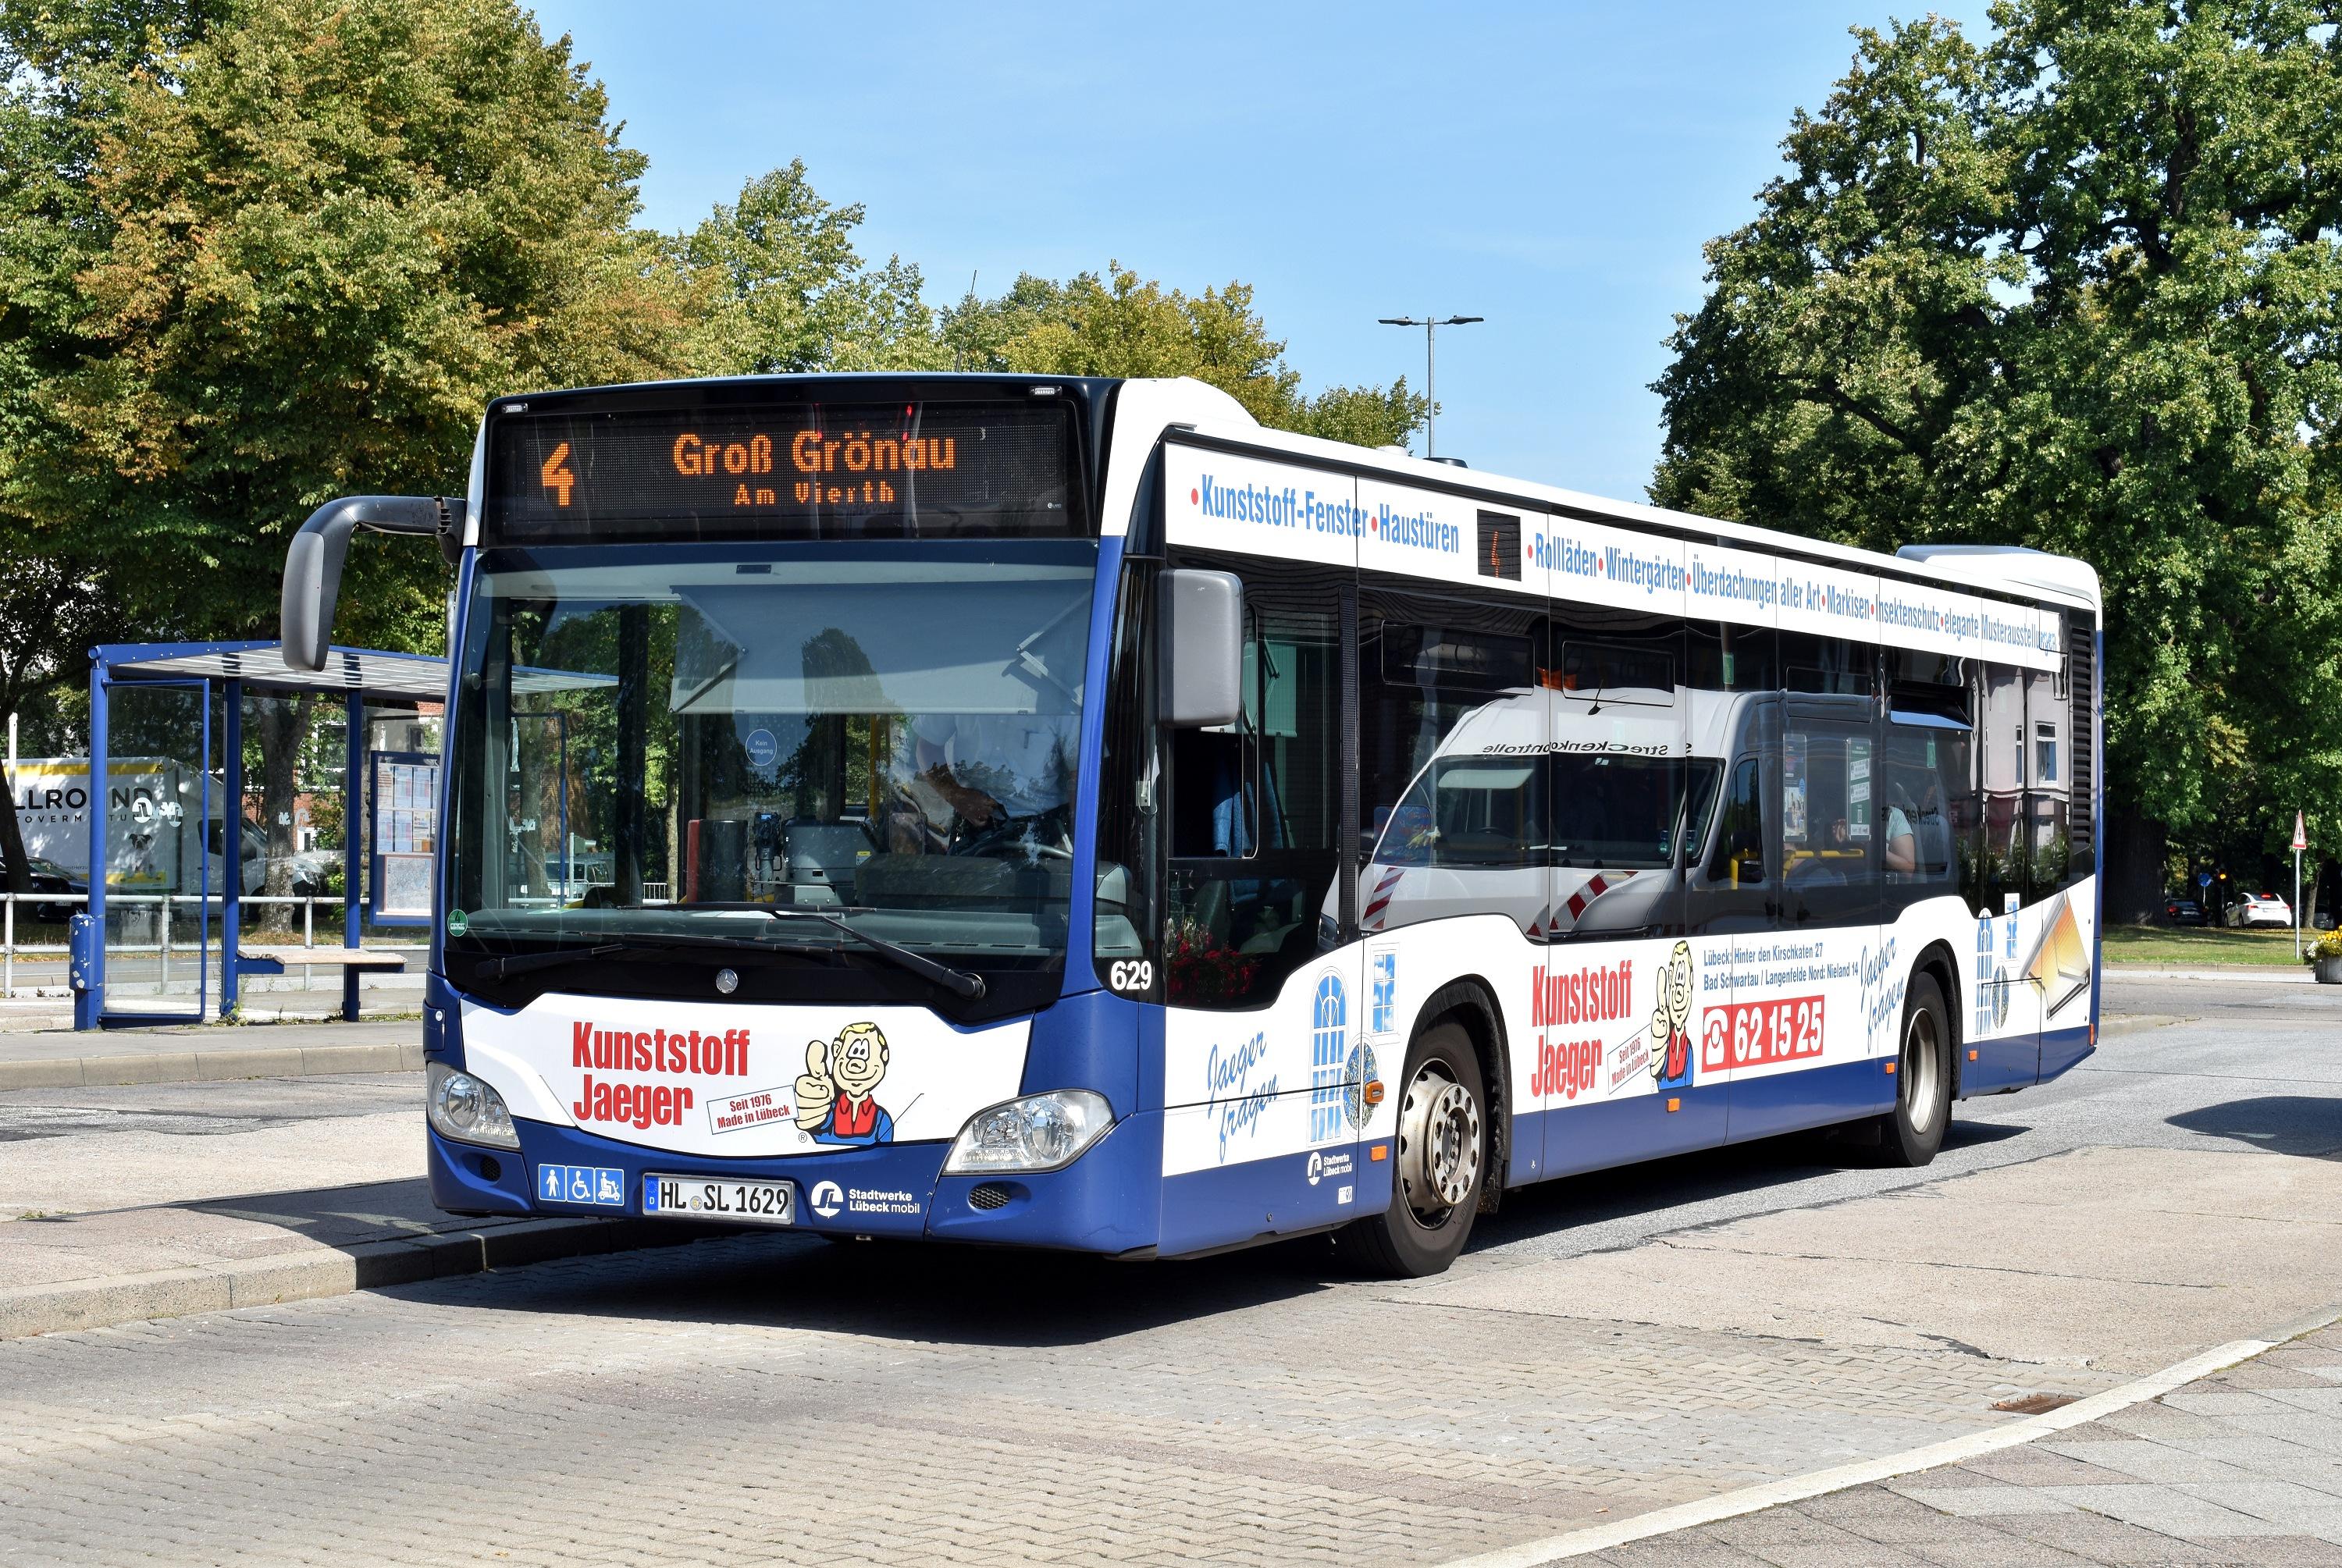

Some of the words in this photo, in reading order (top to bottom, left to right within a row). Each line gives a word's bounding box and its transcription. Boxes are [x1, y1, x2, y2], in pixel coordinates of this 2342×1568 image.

[673, 434, 772, 475] Groß
[792, 430, 956, 471] Grönau
[542, 443, 575, 507] 4
[735, 483, 776, 505] Am
[795, 481, 895, 504] Vierth
[1201, 474, 1369, 539] Kunststoff-Fenster
[1379, 503, 1460, 553] Haustüren
[1536, 532, 1596, 578] Rollläden
[1605, 546, 1685, 595] Wintergärten
[1692, 553, 1777, 610] Überdachungen
[1781, 576, 1803, 609] aller
[1806, 581, 1821, 612] Art
[1827, 585, 1870, 620] Markisen
[1875, 593, 1940, 632] Insektenschutz
[1945, 607, 1979, 642] elegante
[1734, 947, 1756, 964] Hinter
[1758, 946, 1771, 962] den
[1772, 944, 1813, 960] Kirschkaten
[1815, 942, 1824, 958] 27
[1110, 961, 1152, 990] 629
[1531, 959, 1632, 1027] Kunststoff
[1703, 973, 1718, 991] Bad
[1720, 972, 1759, 989] Schwartau
[1765, 965, 1806, 987] Langenfelde
[1809, 964, 1825, 980] Nord:
[1827, 962, 1850, 978] Nieland
[1852, 961, 1859, 976] 14
[1860, 936, 1897, 1015] Jaeger
[1734, 1008, 1762, 1062] 62
[1768, 1004, 1792, 1055] 15
[1797, 1001, 1823, 1053] 25
[1867, 975, 1905, 1056] fragen
[573, 1021, 750, 1077] Kunststoff
[1619, 1045, 1629, 1064] Seit
[1207, 1030, 1267, 1120] Jaeger
[1531, 1034, 1602, 1100] Jaeger
[1611, 1066, 1626, 1086] Made
[1625, 1063, 1632, 1076] in
[1632, 1048, 1650, 1072] Lübeck
[574, 1075, 693, 1130] Jaeger
[717, 1115, 743, 1129] Made
[744, 1112, 755, 1123] in
[755, 1104, 790, 1122] Lübeck
[729, 1099, 749, 1112] Seit
[749, 1093, 772, 1108] 1976
[1219, 1073, 1279, 1164] fragen
[1323, 1153, 1350, 1166] Stadtwerke
[1323, 1165, 1340, 1177] Lübeck
[1340, 1163, 1353, 1174] mobil
[649, 1196, 655, 1205] D
[660, 1182, 687, 1209] HL
[703, 1184, 730, 1212] SL
[735, 1186, 789, 1215] 1629
[849, 1189, 913, 1201] Stadtwerke
[849, 1202, 890, 1212] Lübeck
[891, 1203, 920, 1214] mobil
